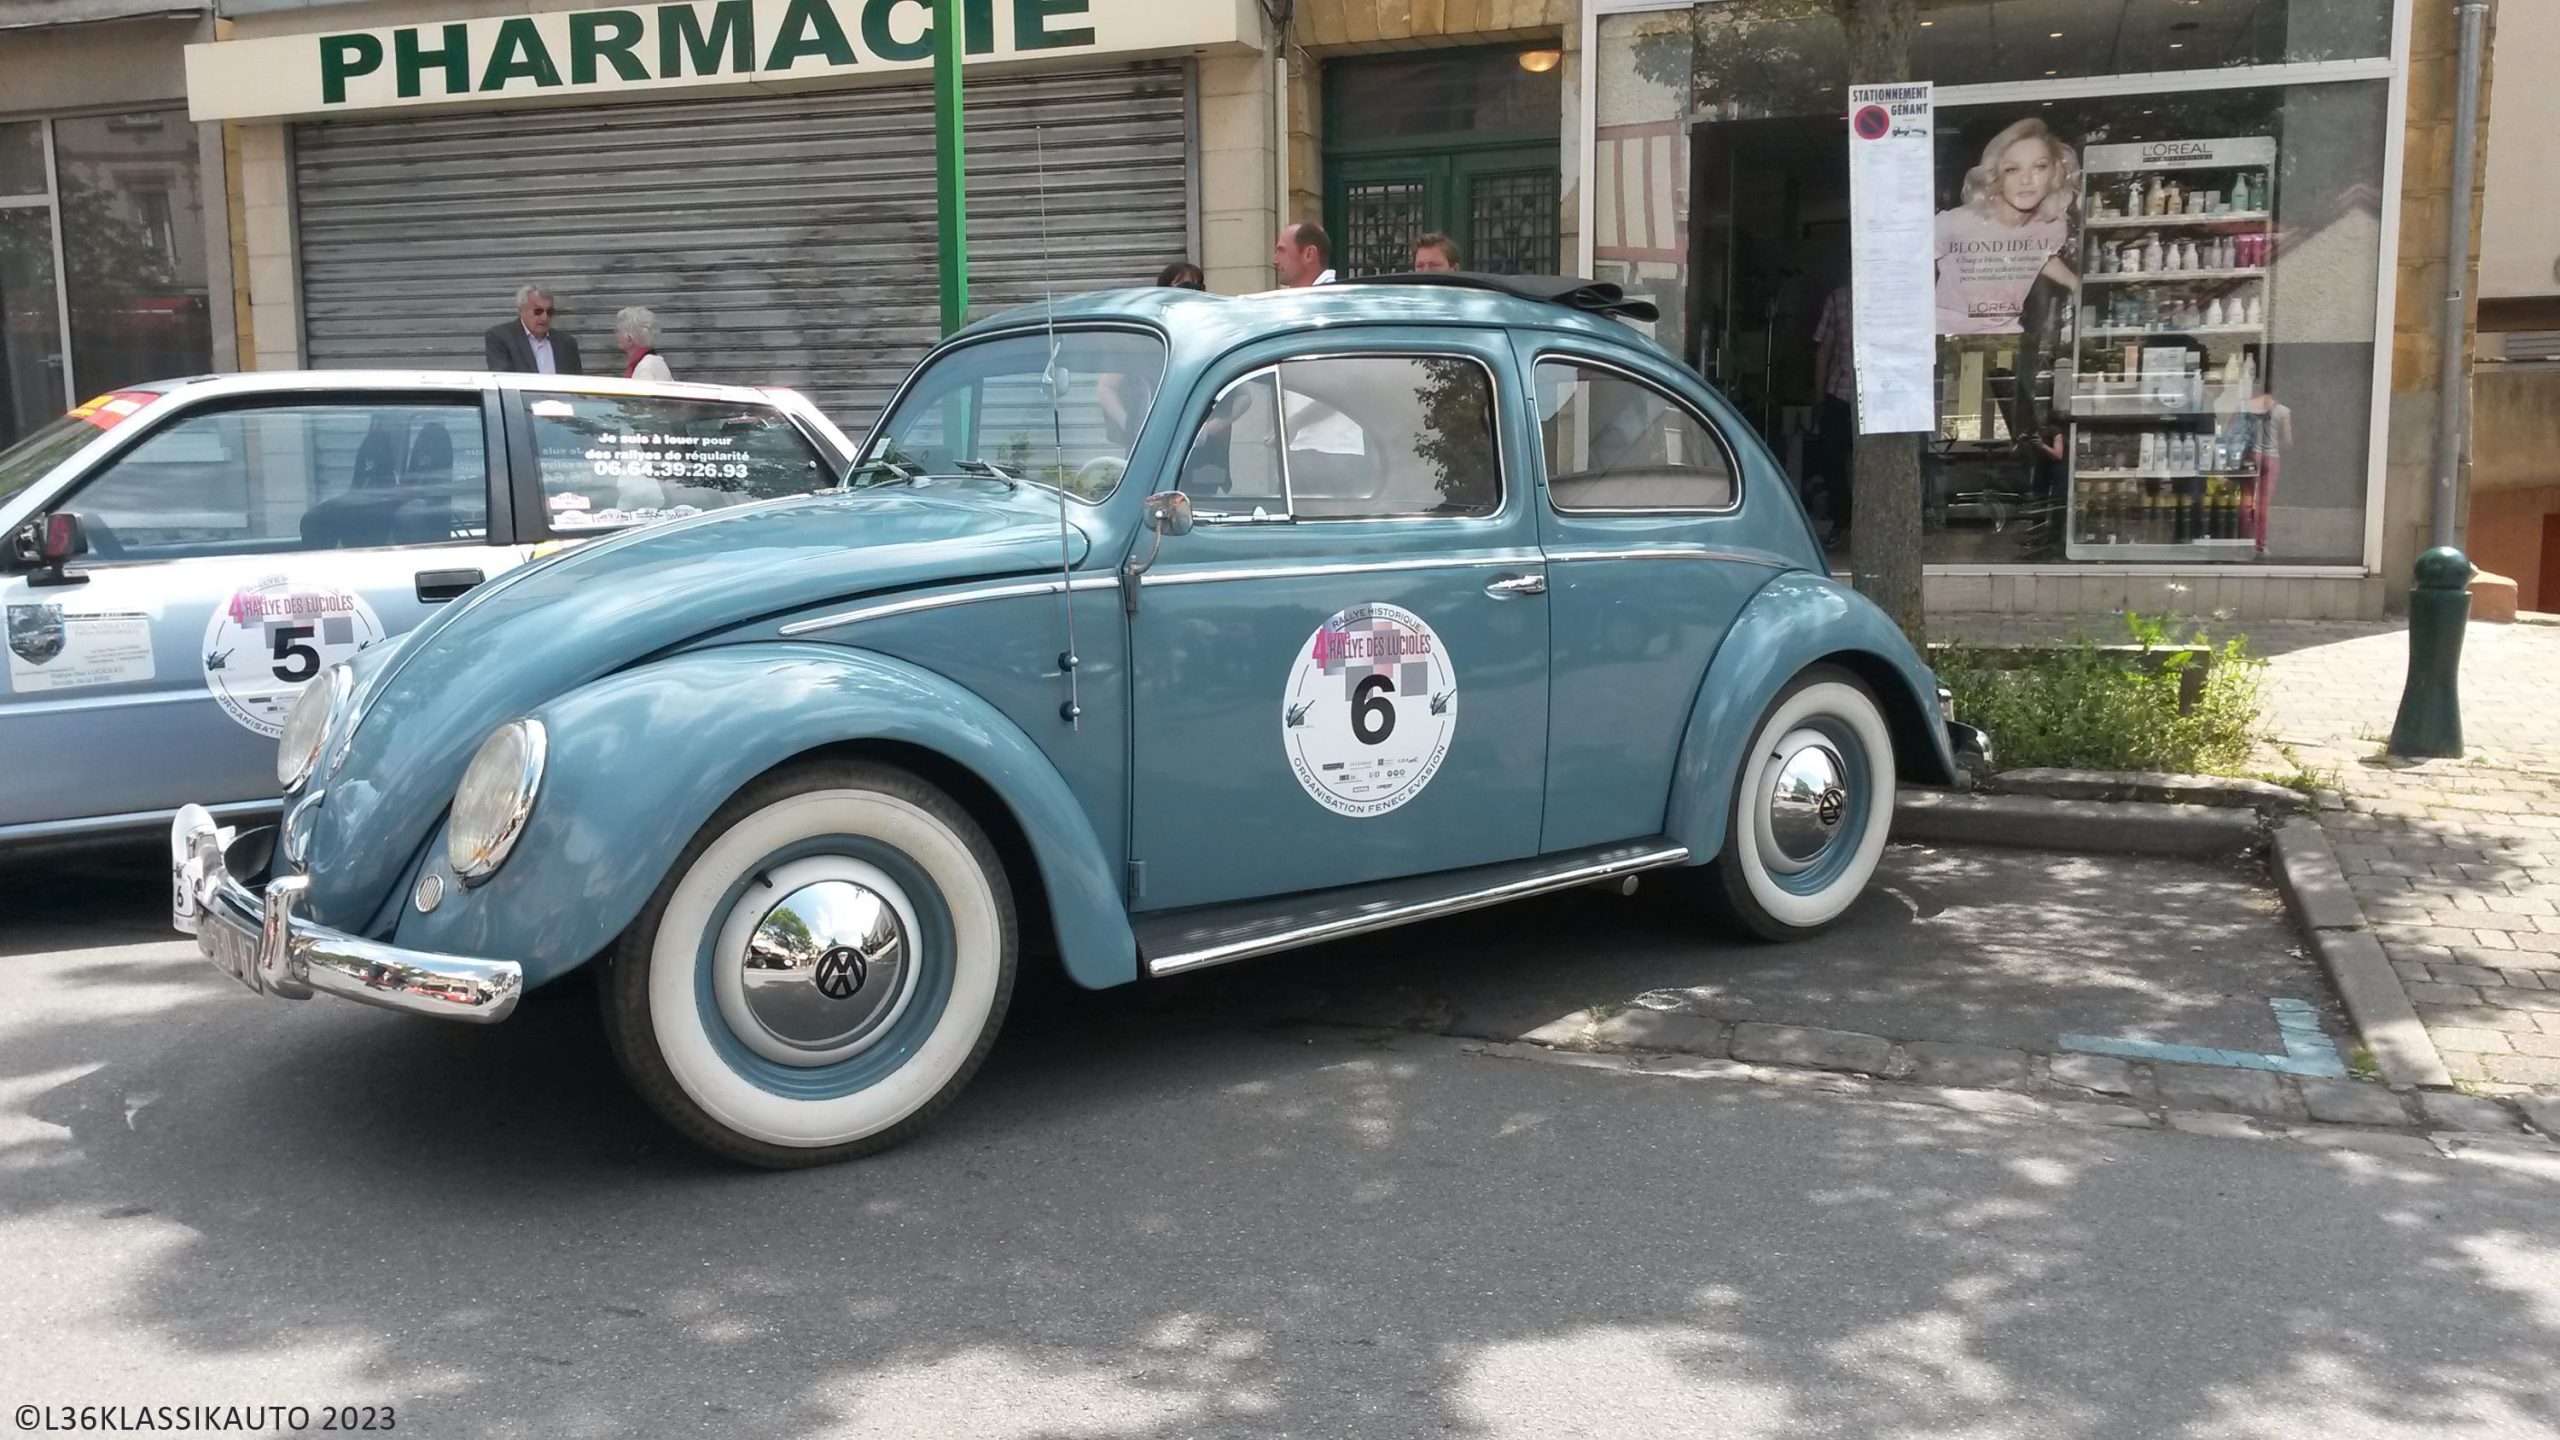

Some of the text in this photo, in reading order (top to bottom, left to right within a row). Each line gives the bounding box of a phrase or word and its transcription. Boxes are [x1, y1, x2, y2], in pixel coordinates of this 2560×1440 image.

[319, 0, 1096, 104] PHARMACIE
[1852, 86, 1928, 102] STATIONNEMENT
[1949, 240, 2003, 254] BLOND
[598, 432, 733, 446] Je suis à louer pour
[585, 449, 750, 462] des rallyes de régularité
[594, 460, 748, 478] 06.64.39.26.93
[284, 598, 304, 614] DES
[307, 595, 354, 613] LUCIOLES
[1332, 607, 1421, 631] RALLYE HISTORIQUE
[272, 626, 321, 683] 5
[1330, 638, 1364, 660] RALLYE
[1367, 636, 1385, 657] DES
[1387, 634, 1431, 656] LUCIOLES
[218, 692, 284, 737] ORGANISATI
[1351, 674, 1396, 745] 6
[1294, 745, 1446, 814] ORGANISATION FENEC EVASION
[176, 885, 185, 908] 6
